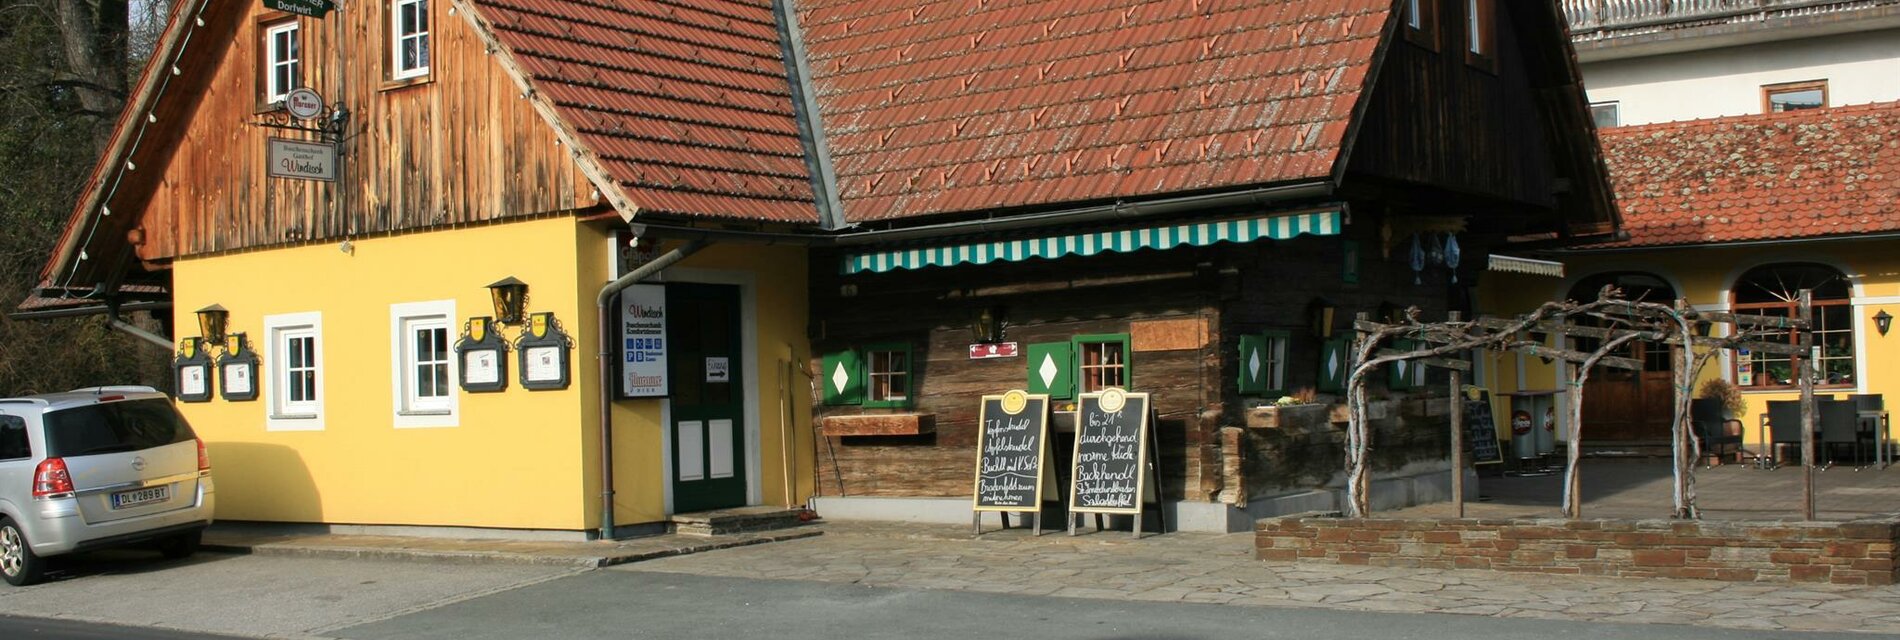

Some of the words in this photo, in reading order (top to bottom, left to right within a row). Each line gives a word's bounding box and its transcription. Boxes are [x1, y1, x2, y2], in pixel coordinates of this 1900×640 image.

[277, 1, 312, 15] Dorfwirt
[281, 158, 324, 175] Windisch
[628, 304, 663, 319] Windisch
[985, 416, 1030, 438] Topfenstrudel
[1089, 411, 1100, 427] bis
[1079, 426, 1138, 447] durchgehend
[984, 434, 1035, 456] Apfelstrudel
[1077, 451, 1110, 463] warme
[1075, 462, 1136, 482] Backhendl
[121, 494, 132, 503] DL
[138, 490, 153, 501] 289
[154, 488, 165, 498] BT
[982, 491, 1023, 502] mitnehmen
